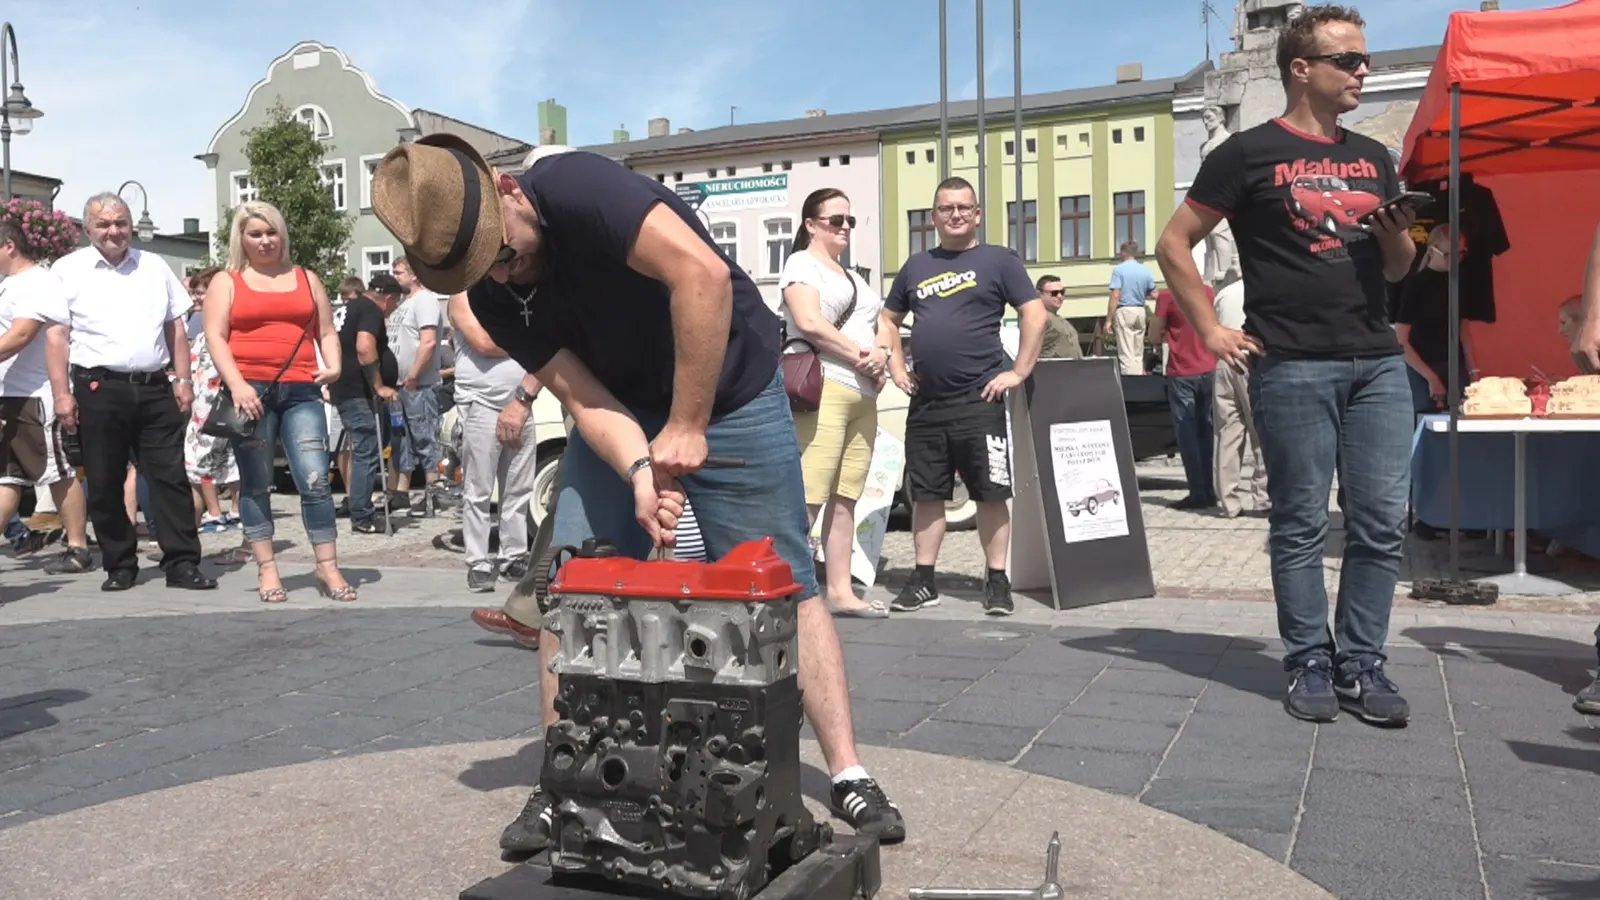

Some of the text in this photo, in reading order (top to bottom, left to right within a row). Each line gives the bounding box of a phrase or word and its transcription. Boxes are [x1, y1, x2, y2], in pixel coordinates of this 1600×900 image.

[1274, 158, 1377, 186] Maluch
[705, 177, 786, 192] NIERUCHOMOŚCI
[1310, 238, 1342, 253] IKONA
[916, 270, 977, 300] umbro
